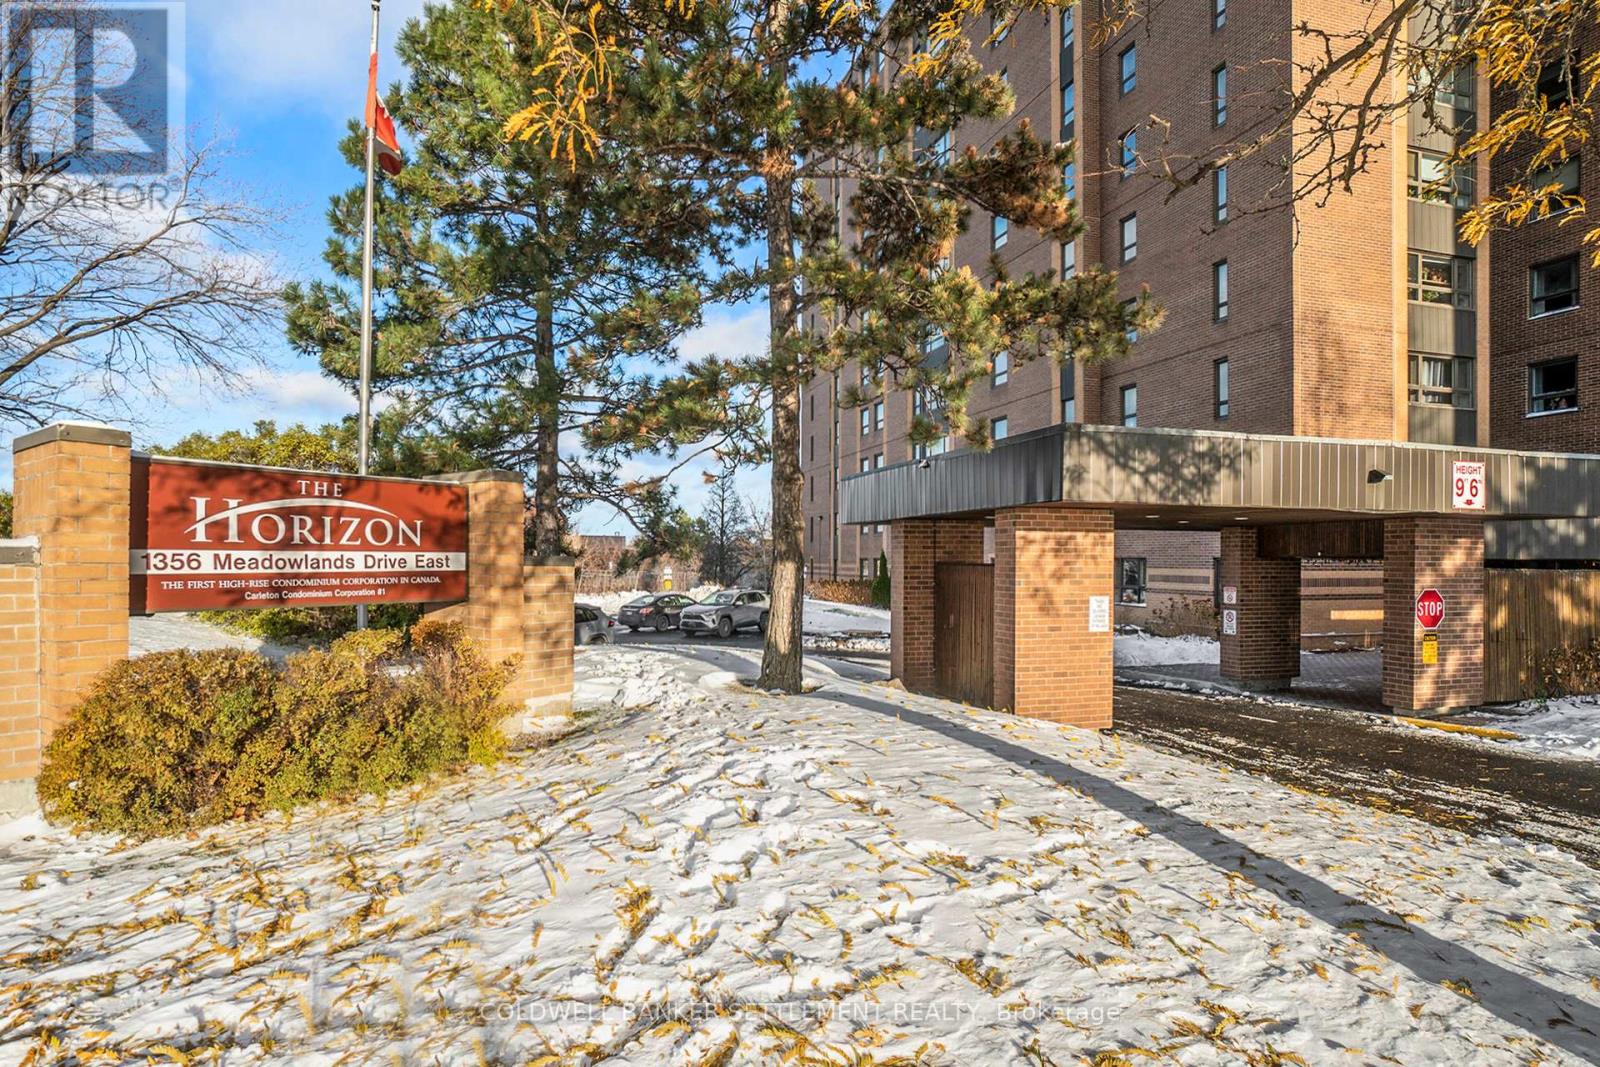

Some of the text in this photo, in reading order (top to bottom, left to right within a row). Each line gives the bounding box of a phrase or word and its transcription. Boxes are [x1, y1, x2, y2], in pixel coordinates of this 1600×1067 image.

[1456, 465, 1482, 474] HEIGHT
[297, 480, 342, 497] THE
[186, 496, 423, 547] HORIZON
[141, 552, 450, 571] 1356 Meadowlands Drive East
[161, 576, 441, 590] THE FIRST HIGH-RISE CONDOMINIUM CORPORATION IN CANADA
[245, 591, 279, 600] Carleton
[282, 590, 333, 599] Condominium
[335, 588, 375, 597] Corporation
[1417, 601, 1443, 616] STOP
